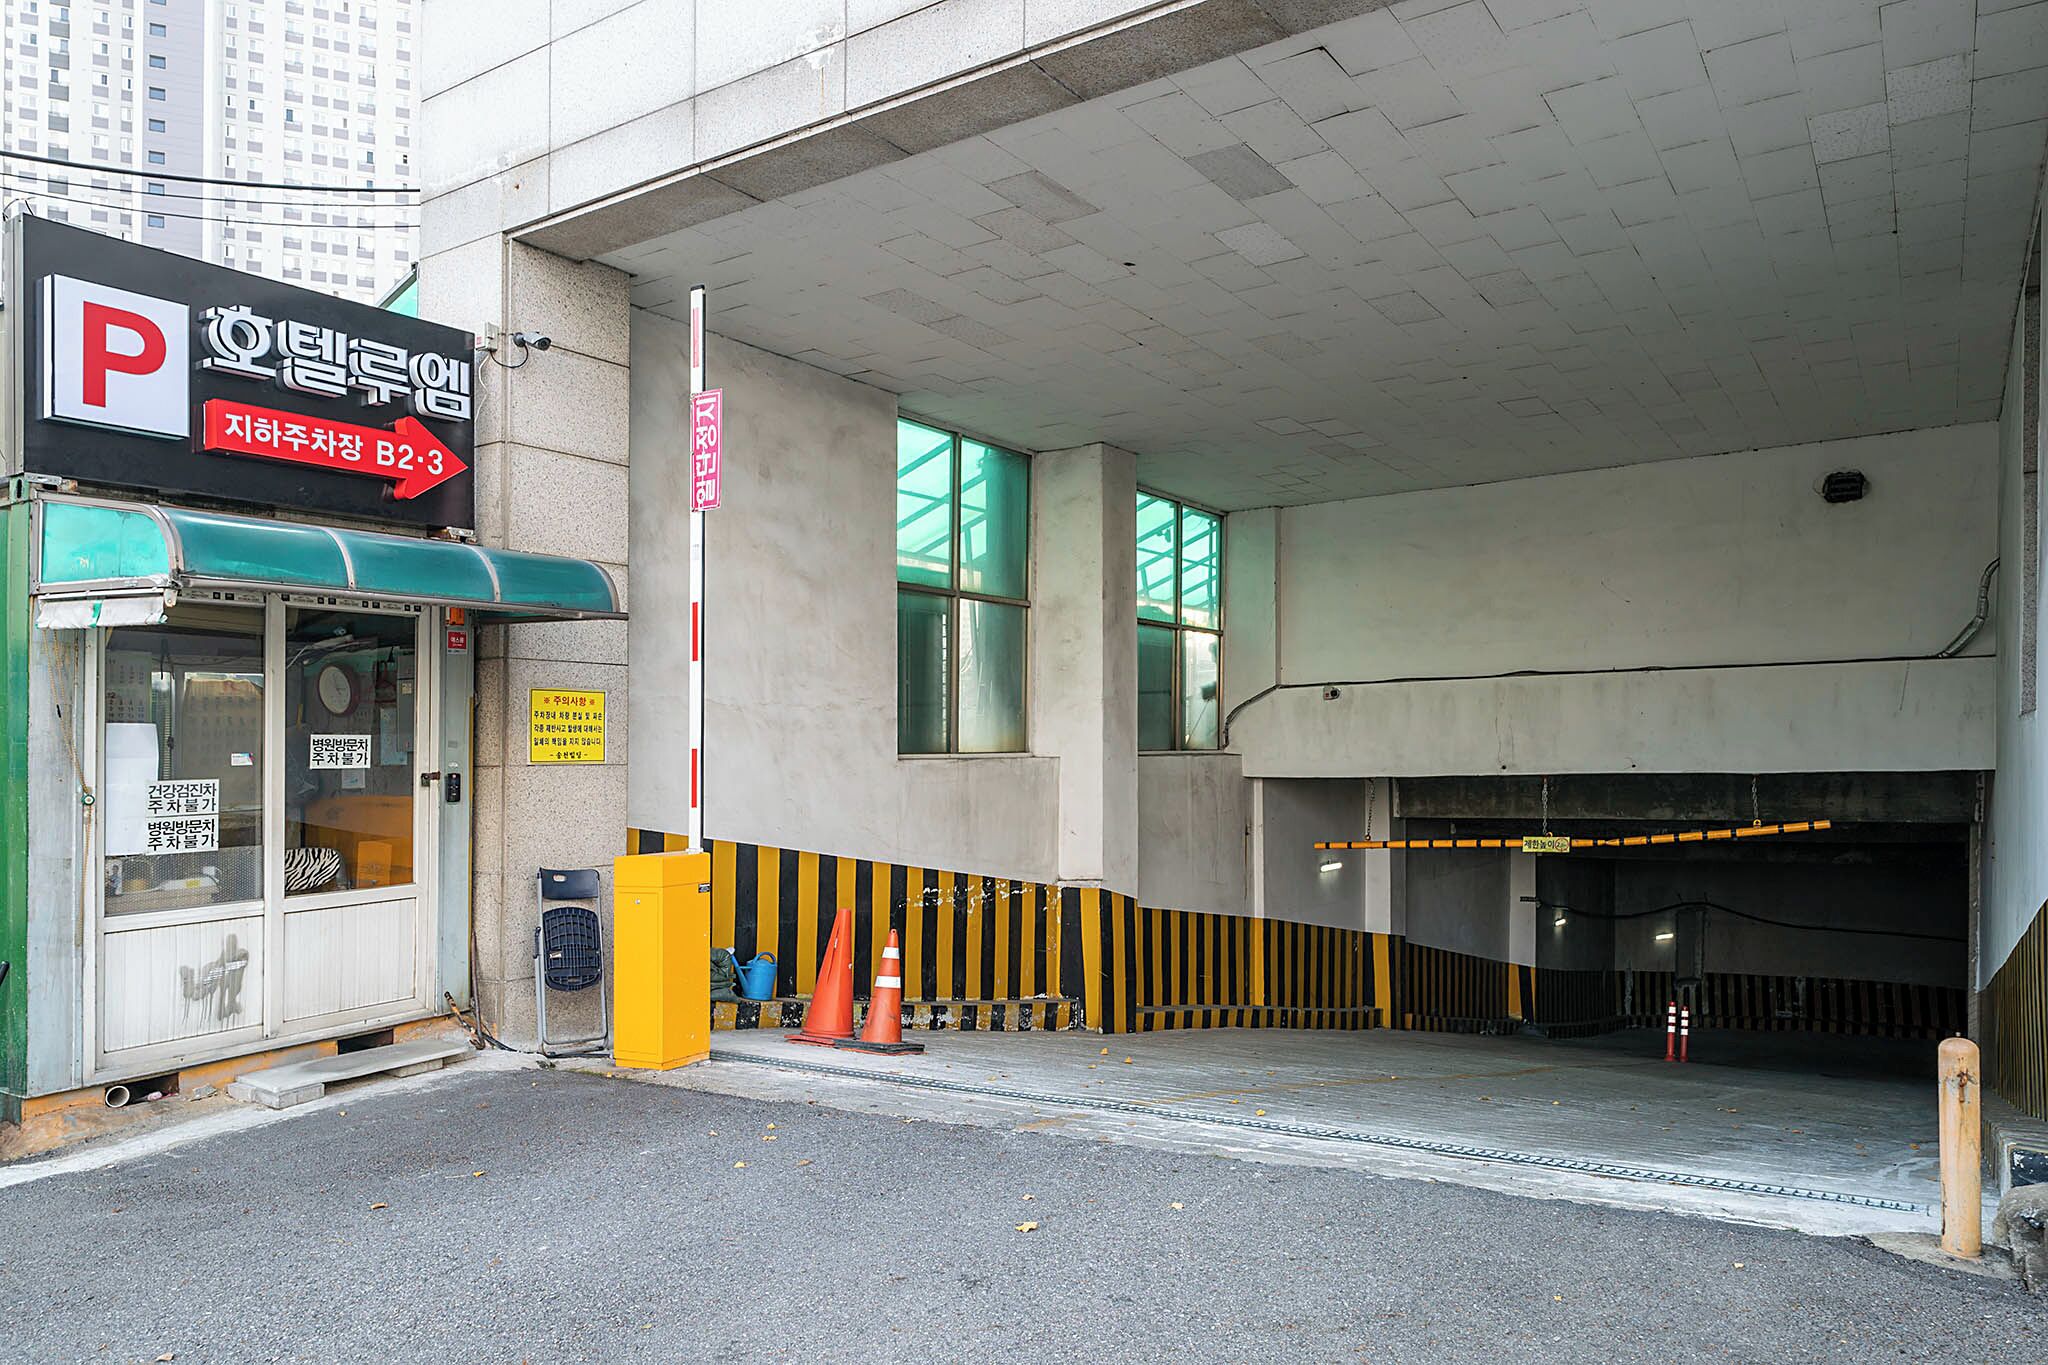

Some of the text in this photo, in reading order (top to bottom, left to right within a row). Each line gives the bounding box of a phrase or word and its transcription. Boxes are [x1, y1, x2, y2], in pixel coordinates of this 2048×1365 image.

[83, 301, 166, 408] P
[202, 305, 471, 422] 호텔루엠
[225, 413, 363, 461] 지하주차장
[696, 397, 717, 504] 일단정지
[553, 696, 587, 706] 주의사항
[312, 738, 368, 752] 병원방문차
[148, 783, 217, 799] 건강검진차
[148, 818, 215, 836] 병원방문차
[1524, 840, 1555, 849] 제한높이
